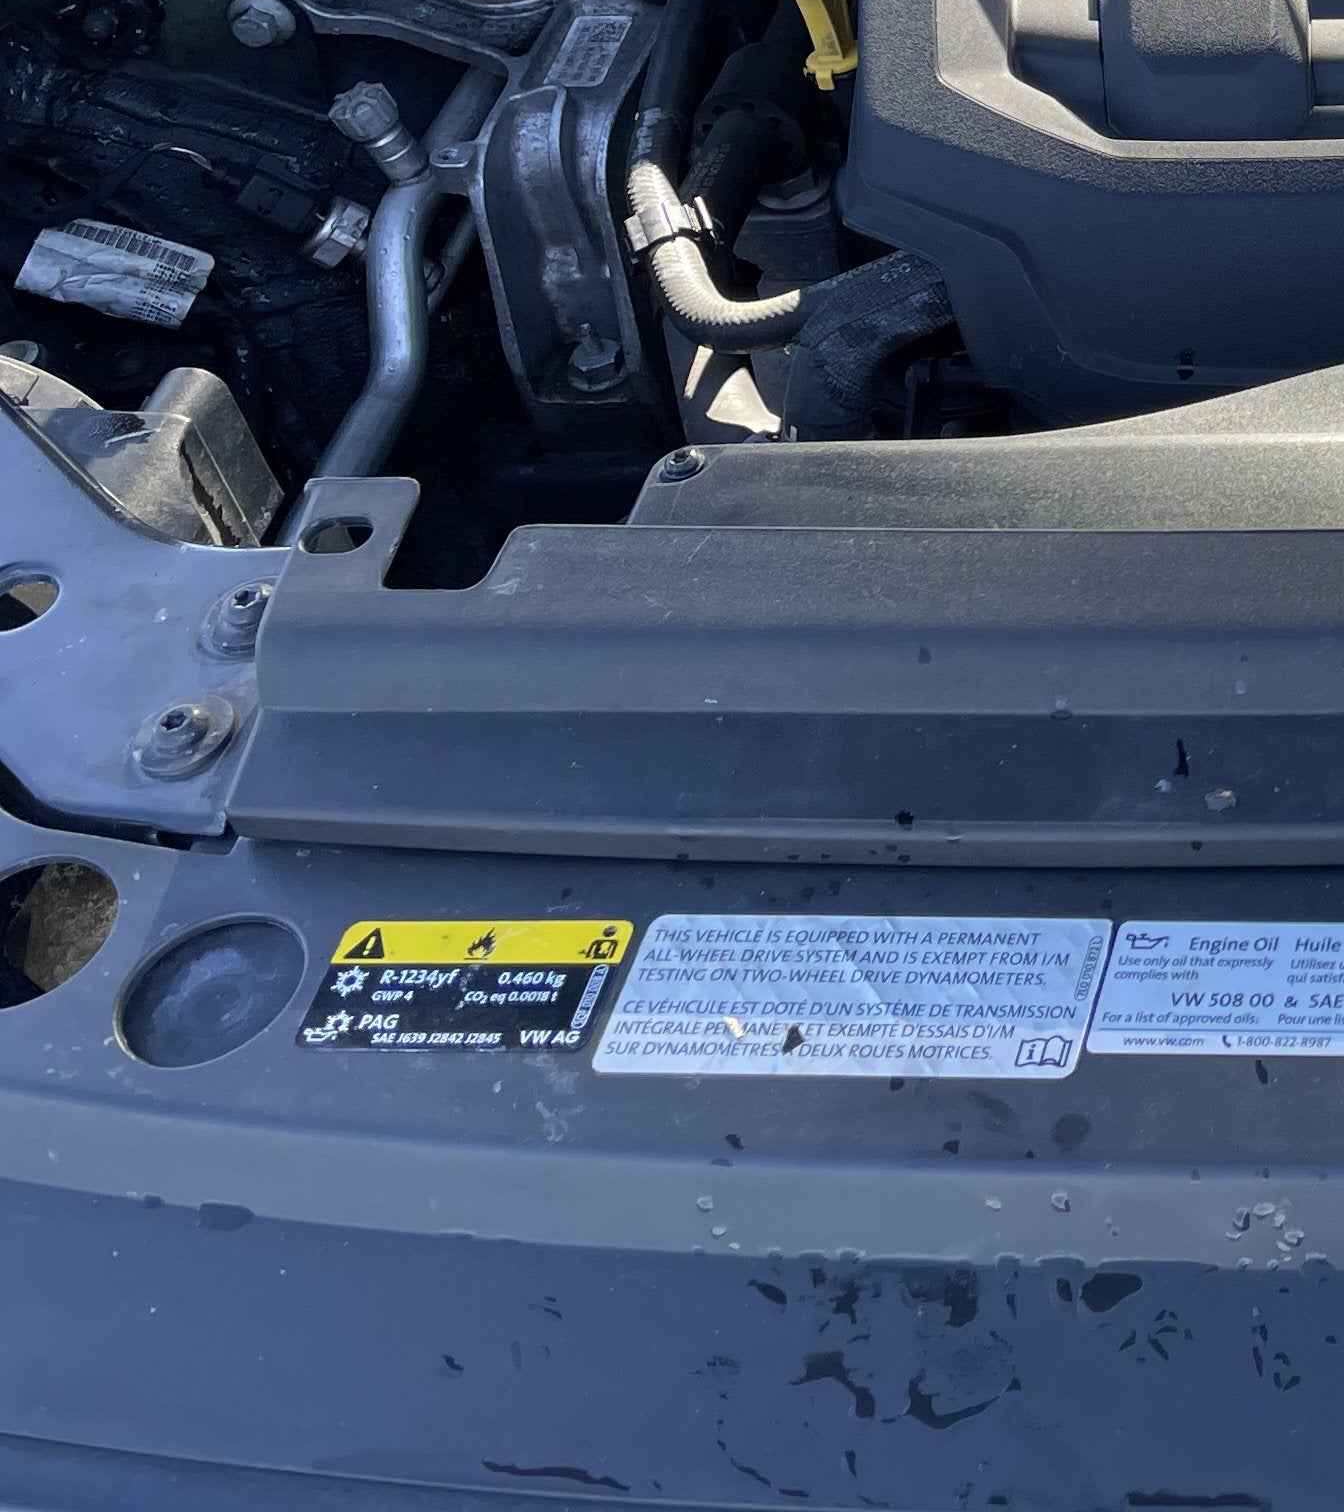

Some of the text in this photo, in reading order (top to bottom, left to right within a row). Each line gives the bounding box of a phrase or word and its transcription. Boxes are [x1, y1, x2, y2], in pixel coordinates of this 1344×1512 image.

[654, 929, 1041, 947] THIS VEHICLE IS EQUIPPED WITH A PERMANENT
[1189, 937, 1278, 954] Engine Oil
[1295, 938, 1340, 953] Huile
[643, 950, 1069, 966] ALL-WHEEL DRIVE SYSTEM AND IS EXEMPT FROM I/M
[1118, 956, 1273, 970] Use only oil that expressly
[1291, 959, 1336, 970] Utilisez
[379, 968, 566, 987] R-1234yf 0.460 kg
[637, 969, 1047, 986] TESTING ON TWO-WHEEL DRIVE DYNAMOMETERS.
[1114, 970, 1199, 981] complies with
[1287, 974, 1307, 986] qui
[372, 992, 402, 1001] GWP
[403, 992, 413, 1001] 4
[1171, 993, 1204, 1007] VW
[1208, 993, 1243, 1007] 508
[1250, 994, 1274, 1007] 00
[1284, 996, 1298, 1007] &
[1309, 994, 1344, 1008] SAE
[623, 1000, 647, 1013] CE
[650, 997, 726, 1015] VÉHICULE
[730, 1001, 758, 1015] EST
[762, 998, 806, 1015] DOTÉ
[810, 1001, 851, 1015] D'UN
[928, 1004, 950, 1017] DE
[956, 1005, 1076, 1019] TRANSMISSION
[359, 1014, 398, 1029] PAG
[1103, 1013, 1121, 1022] For
[1125, 1015, 1132, 1023] a
[1136, 1013, 1153, 1023] list
[1157, 1013, 1169, 1023] of
[1173, 1014, 1230, 1026] approved
[1278, 1014, 1304, 1025] Pour
[1309, 1016, 1331, 1025] une
[519, 1030, 580, 1044] VW AG
[805, 1023, 824, 1036] ET
[901, 1024, 970, 1038] D'ESSAIS
[972, 1025, 1015, 1039] D'I/M
[1123, 1035, 1204, 1047] www.vw.com
[605, 1041, 639, 1055] SUR
[799, 1044, 850, 1057] DEUX
[848, 1045, 908, 1058] ROUES
[908, 1046, 992, 1060] MOTRICES.
